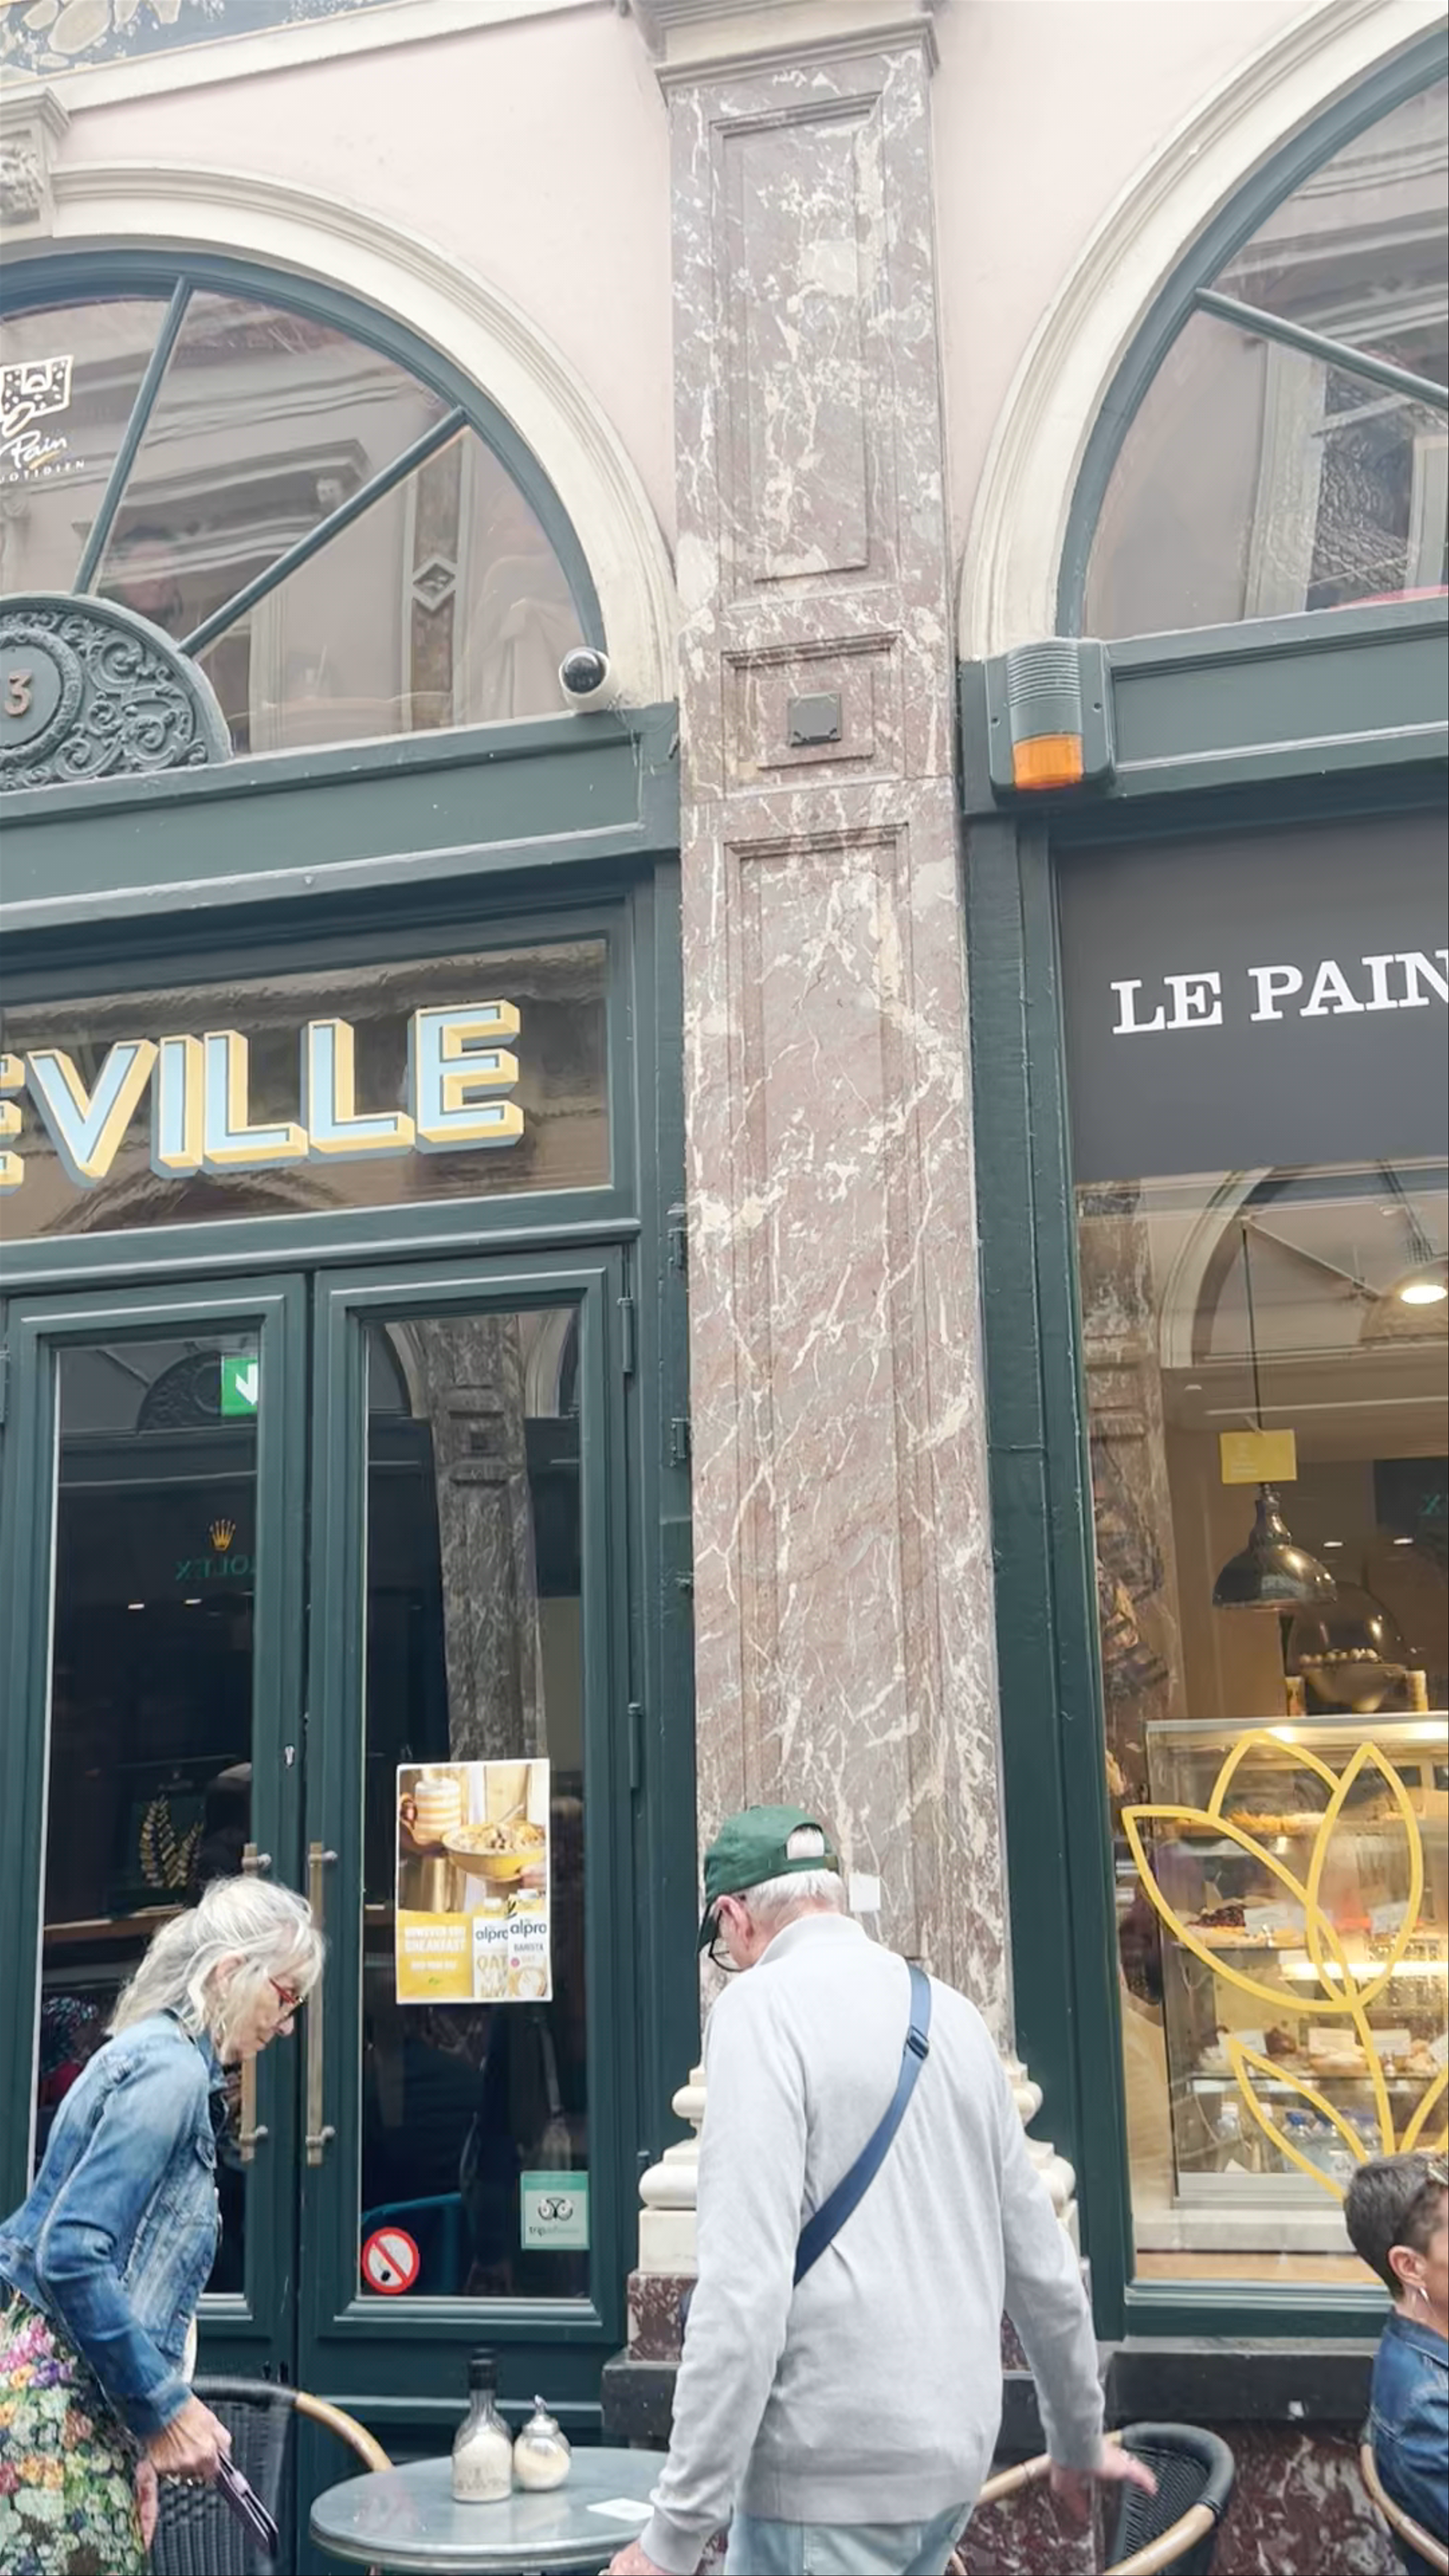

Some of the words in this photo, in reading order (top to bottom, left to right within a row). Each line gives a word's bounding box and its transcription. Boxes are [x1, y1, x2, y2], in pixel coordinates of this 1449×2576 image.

[0, 430, 67, 469] Pain
[1111, 972, 1223, 1034] LE
[1247, 949, 1448, 1021] PAIN
[0, 998, 525, 1195] VILLE
[510, 1919, 547, 1938] alpro
